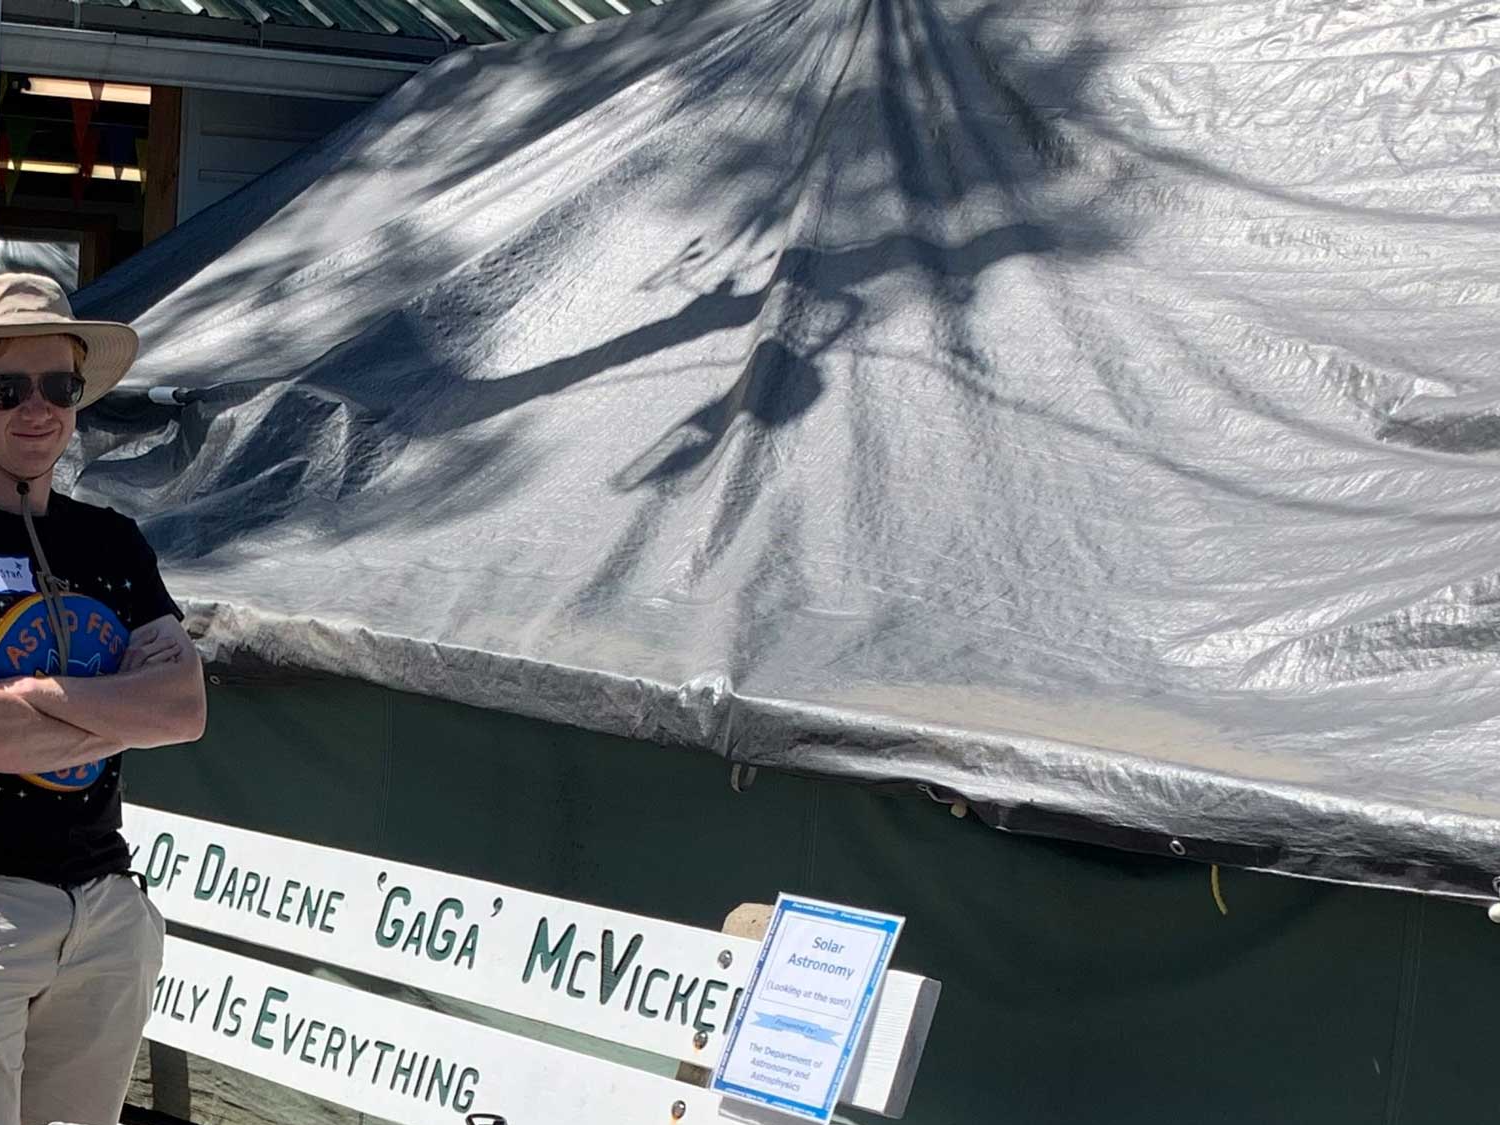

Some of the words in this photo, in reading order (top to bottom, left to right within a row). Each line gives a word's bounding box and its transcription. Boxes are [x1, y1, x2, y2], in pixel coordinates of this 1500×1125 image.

[6, 610, 78, 669] ASTO
[87, 612, 124, 655] FES
[811, 936, 846, 955] Solar
[787, 953, 856, 981] Astronomy
[814, 991, 829, 1002] the
[251, 985, 480, 1114] EVERYTHING
[749, 1042, 763, 1053] The
[764, 1046, 812, 1067] Department
[750, 1057, 793, 1076] Astronomy
[794, 1069, 811, 1081] and
[750, 1071, 801, 1093] Astrophysics
